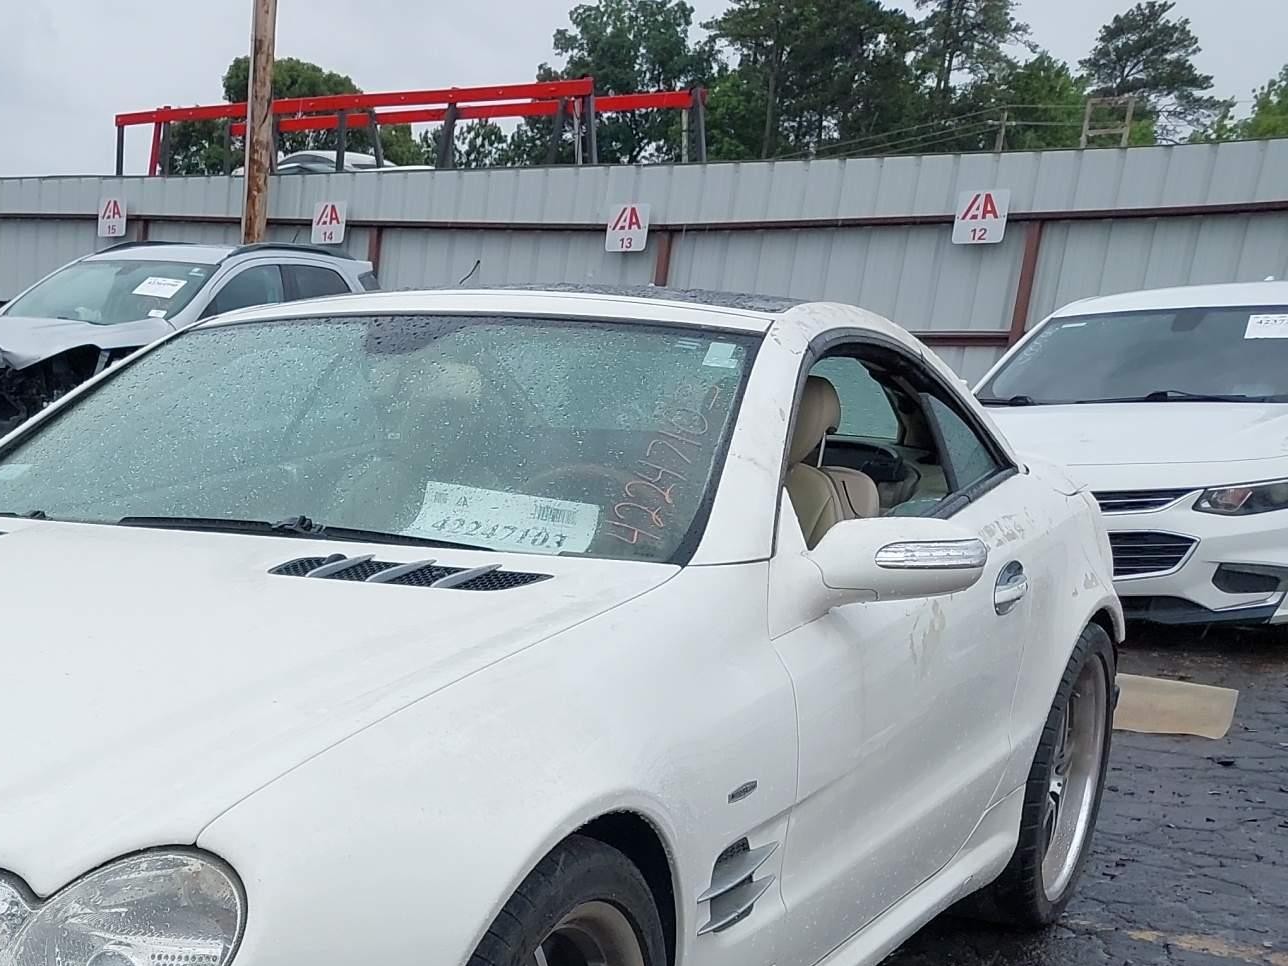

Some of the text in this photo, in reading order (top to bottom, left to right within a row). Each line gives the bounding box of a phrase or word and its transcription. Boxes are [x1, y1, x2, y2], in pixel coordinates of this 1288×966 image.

[107, 225, 117, 235] 15
[970, 228, 987, 241] 12
[323, 231, 334, 242] 14
[619, 237, 633, 249] 13
